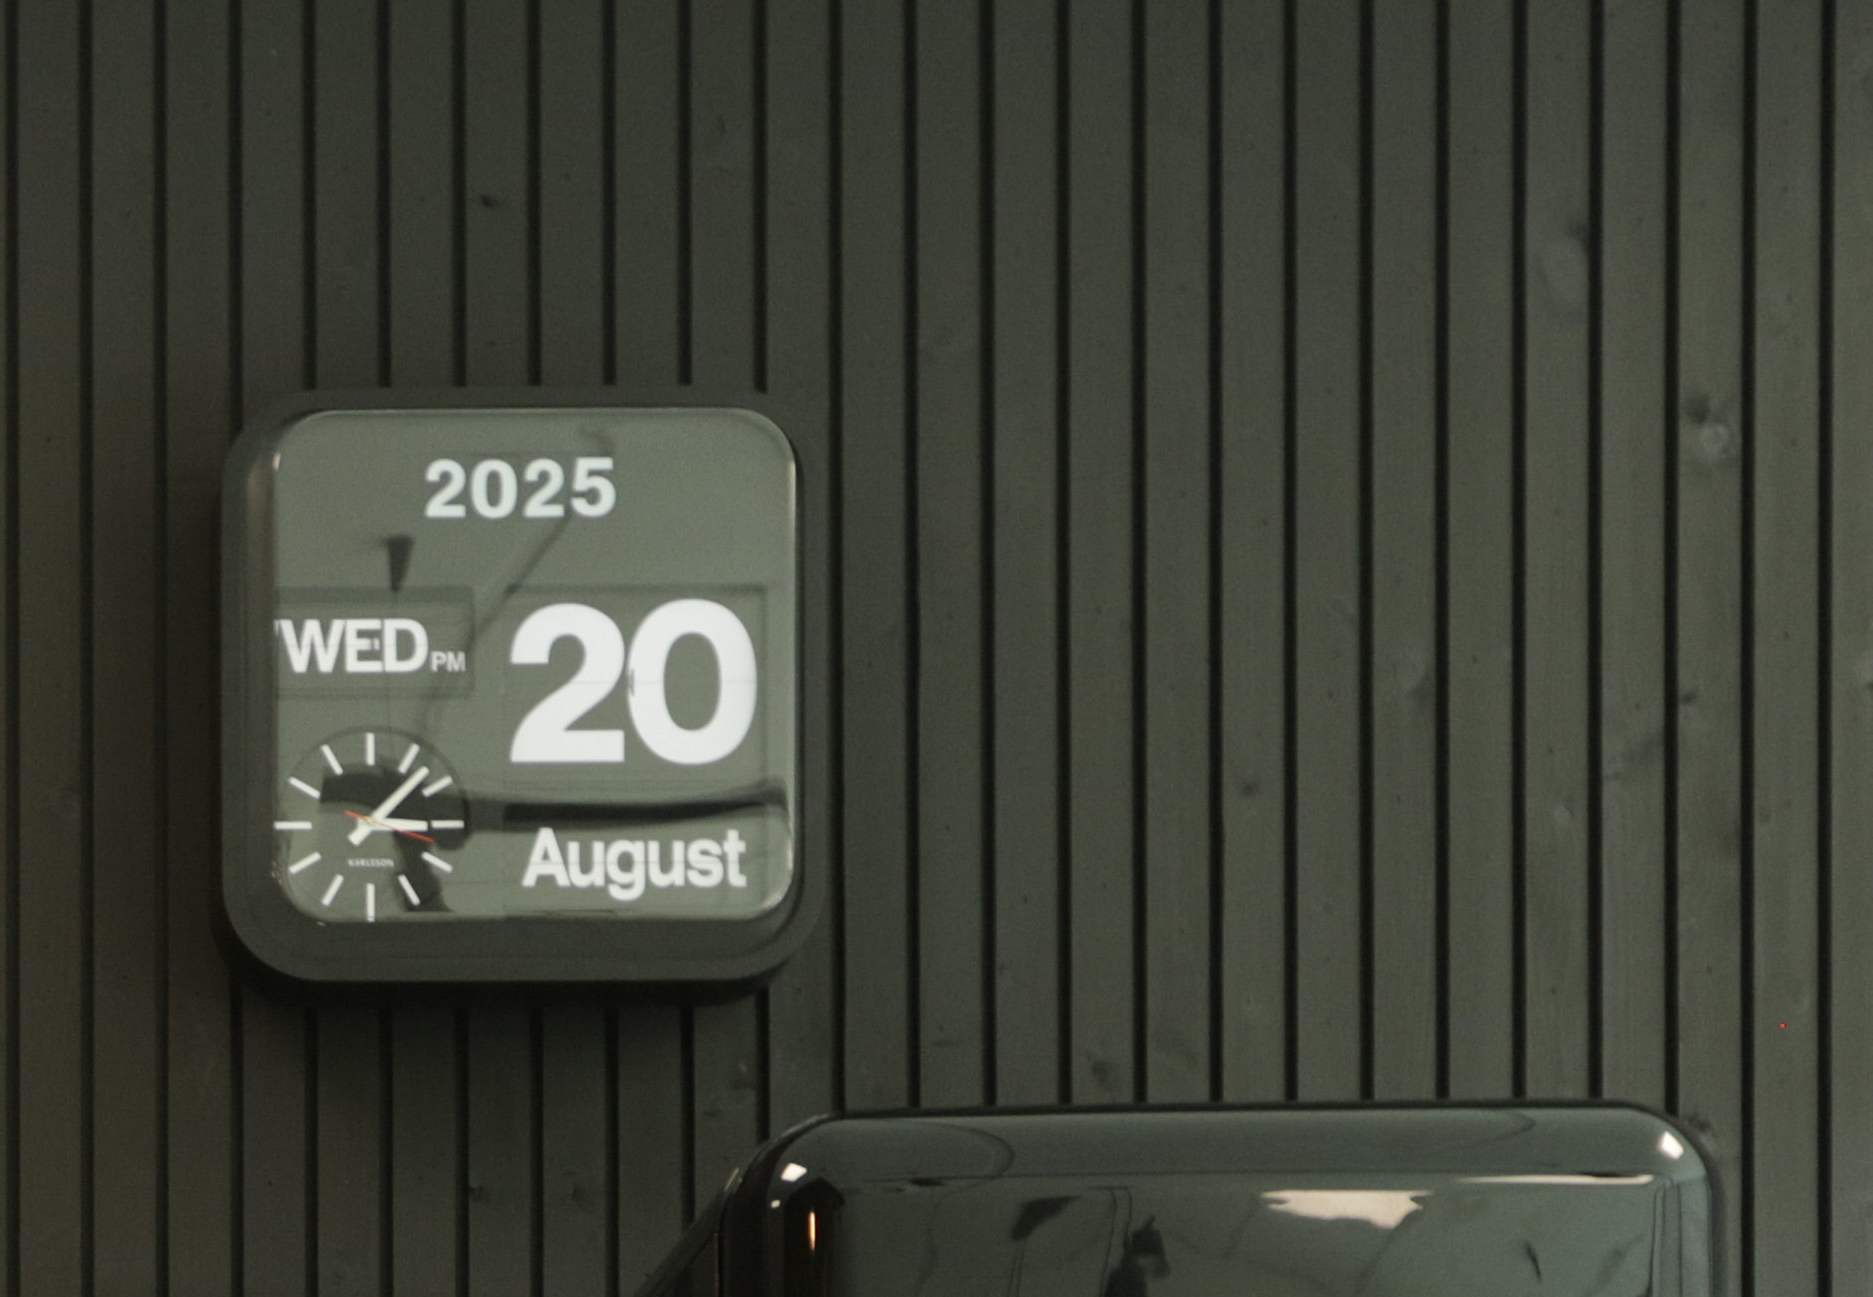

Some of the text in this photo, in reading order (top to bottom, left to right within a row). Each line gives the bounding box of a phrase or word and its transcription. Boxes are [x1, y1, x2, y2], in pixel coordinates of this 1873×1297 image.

[425, 457, 617, 519] 2025
[278, 618, 466, 673] WED PM
[510, 599, 757, 765] 20
[521, 827, 747, 901] August
